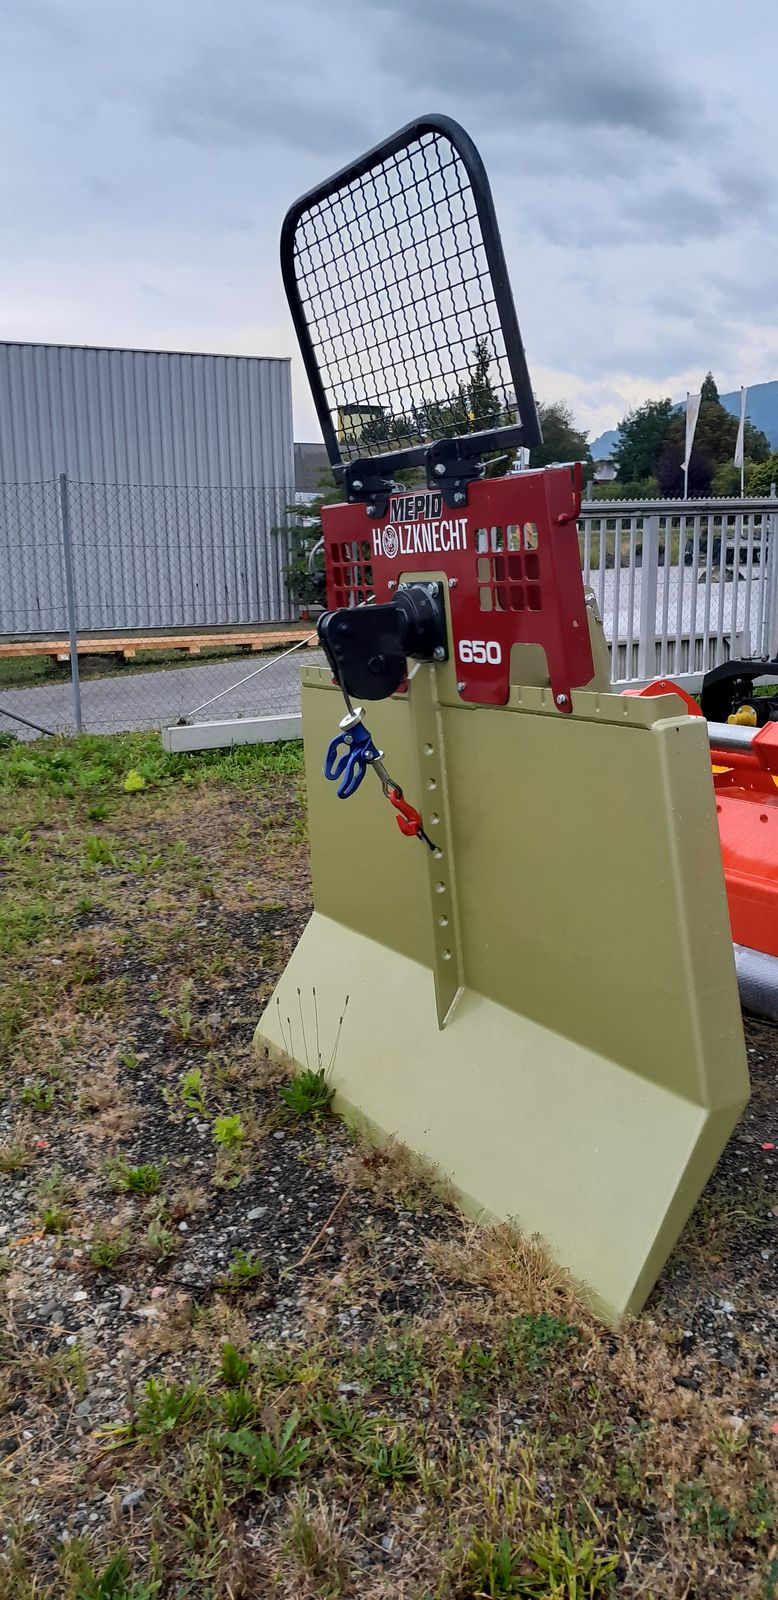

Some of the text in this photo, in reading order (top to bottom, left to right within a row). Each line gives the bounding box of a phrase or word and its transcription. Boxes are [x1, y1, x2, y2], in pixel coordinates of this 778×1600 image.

[389, 492, 443, 523] MEPID
[372, 518, 468, 559] HOLZKNECHT
[458, 639, 502, 665] 650
